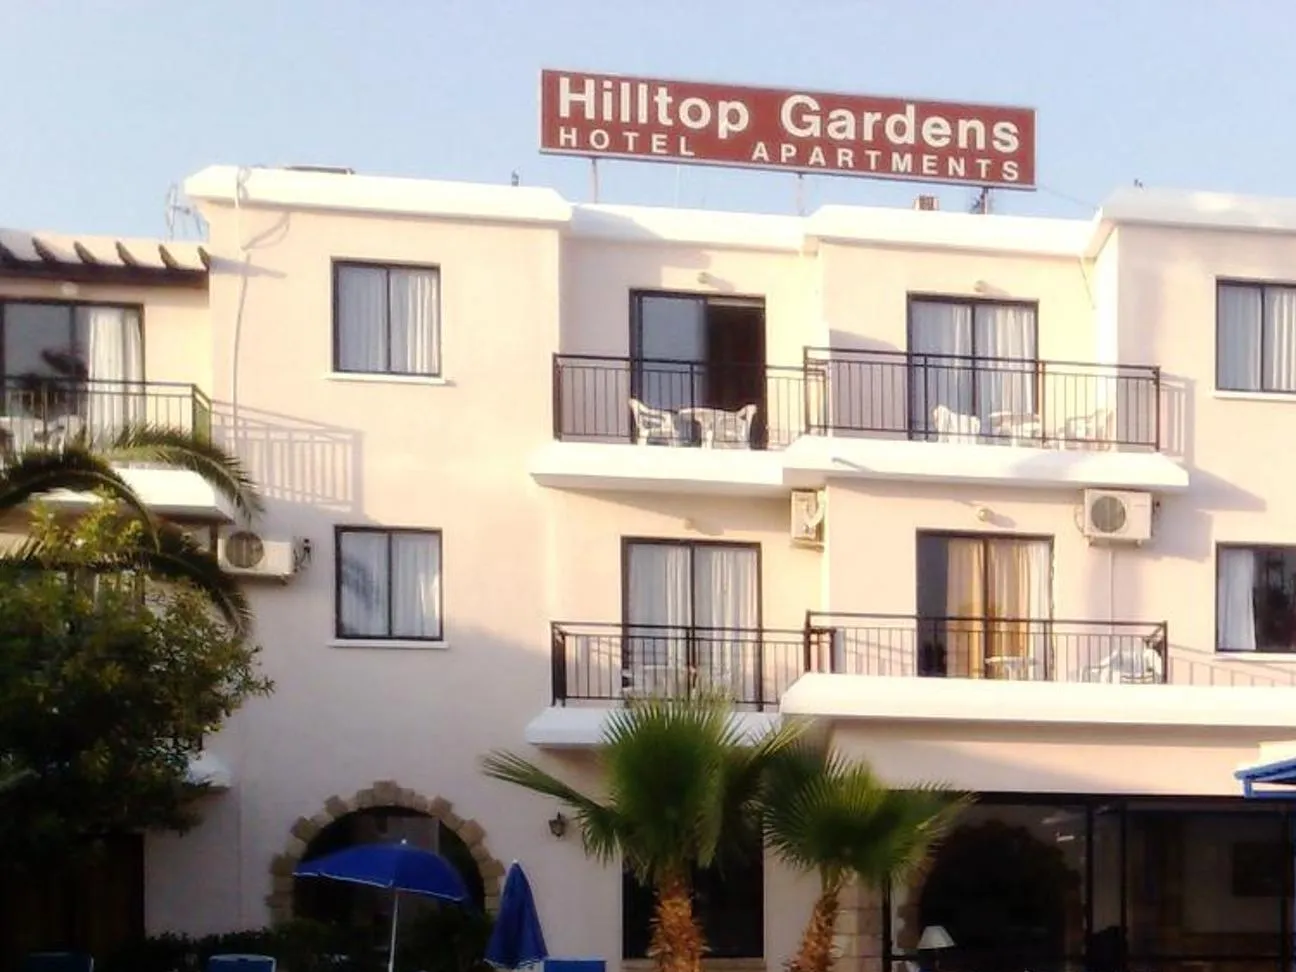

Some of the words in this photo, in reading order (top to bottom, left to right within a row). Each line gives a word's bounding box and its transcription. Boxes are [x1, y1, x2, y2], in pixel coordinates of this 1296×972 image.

[558, 77, 749, 138] Hilltop
[780, 94, 1019, 153] Gardens
[559, 127, 695, 157] HOTEL
[752, 142, 1019, 181] APARTMENTS
